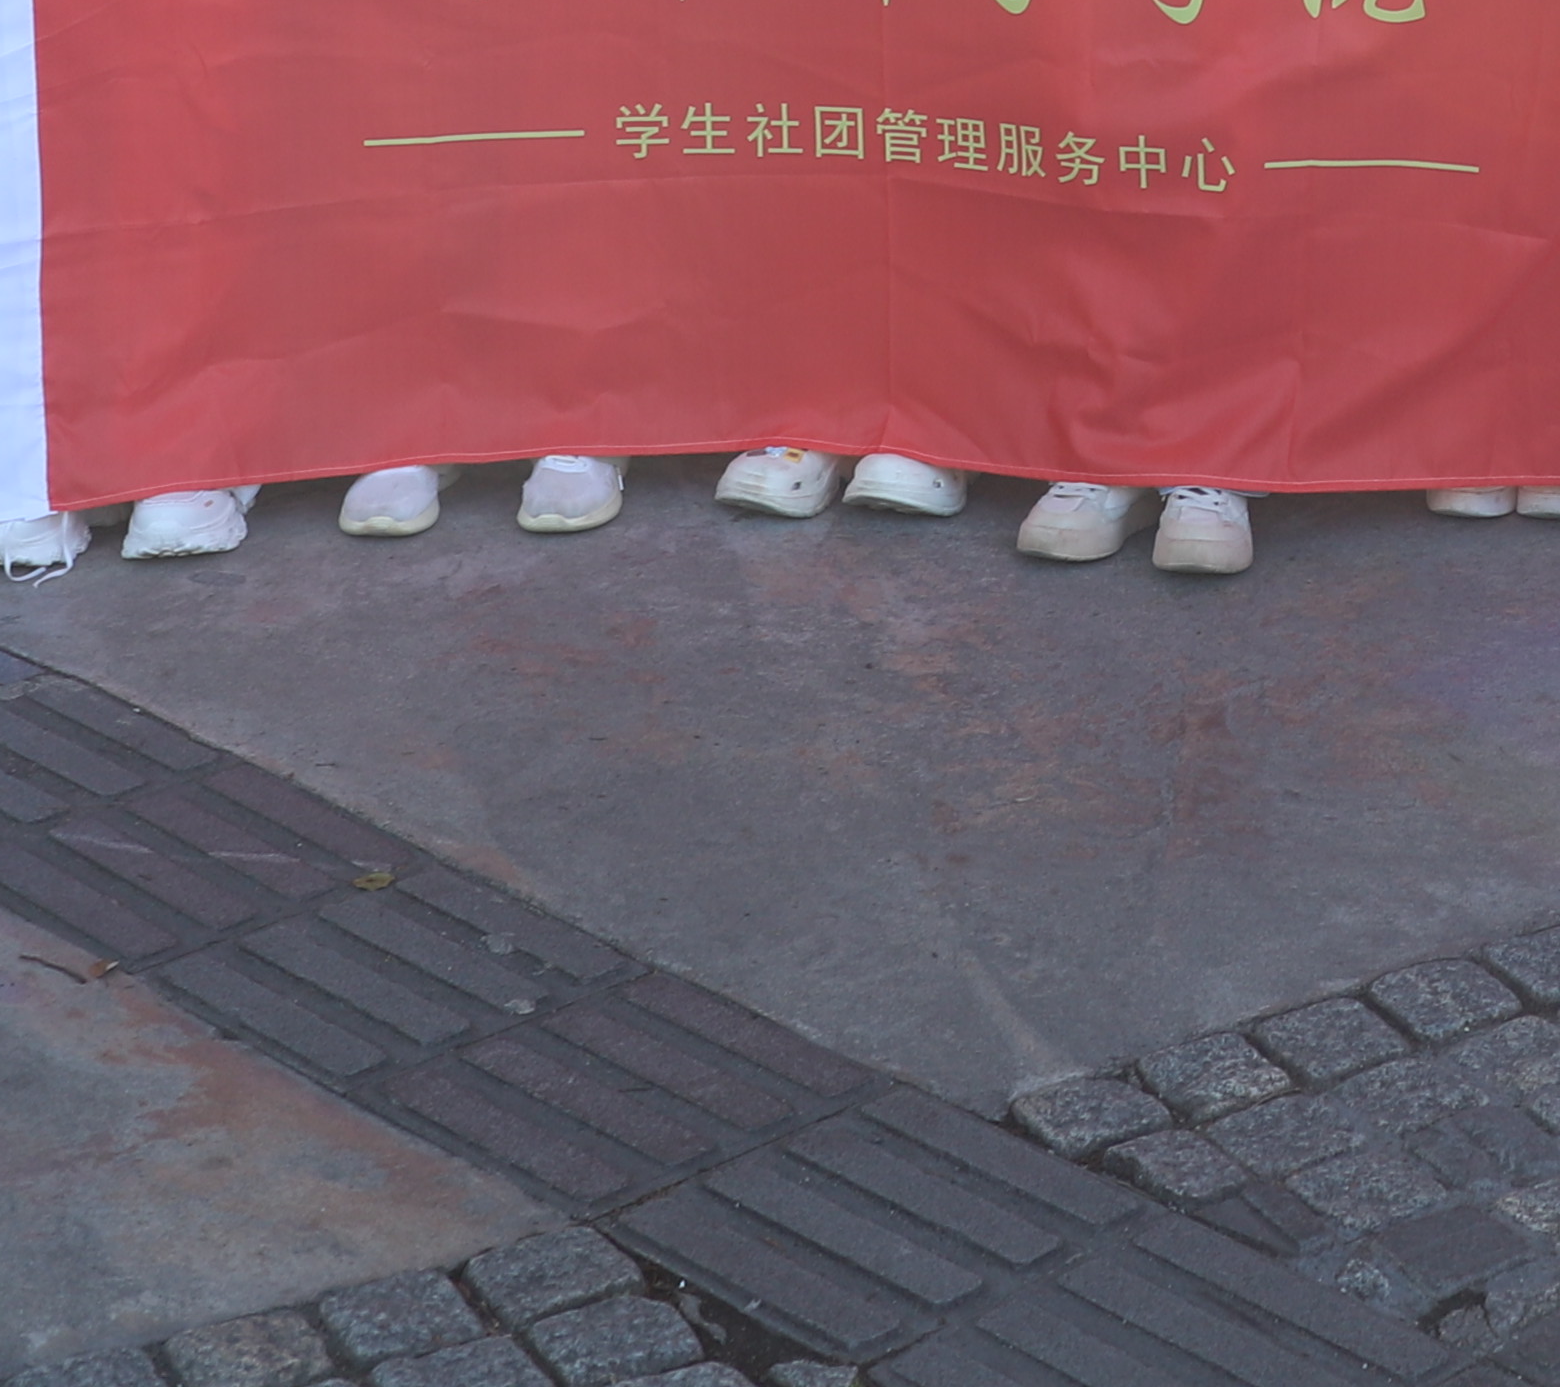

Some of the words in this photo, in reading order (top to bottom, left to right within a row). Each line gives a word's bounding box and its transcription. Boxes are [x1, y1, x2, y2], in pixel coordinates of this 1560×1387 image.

[616, 102, 1237, 194] 学生社团管理服务中心
